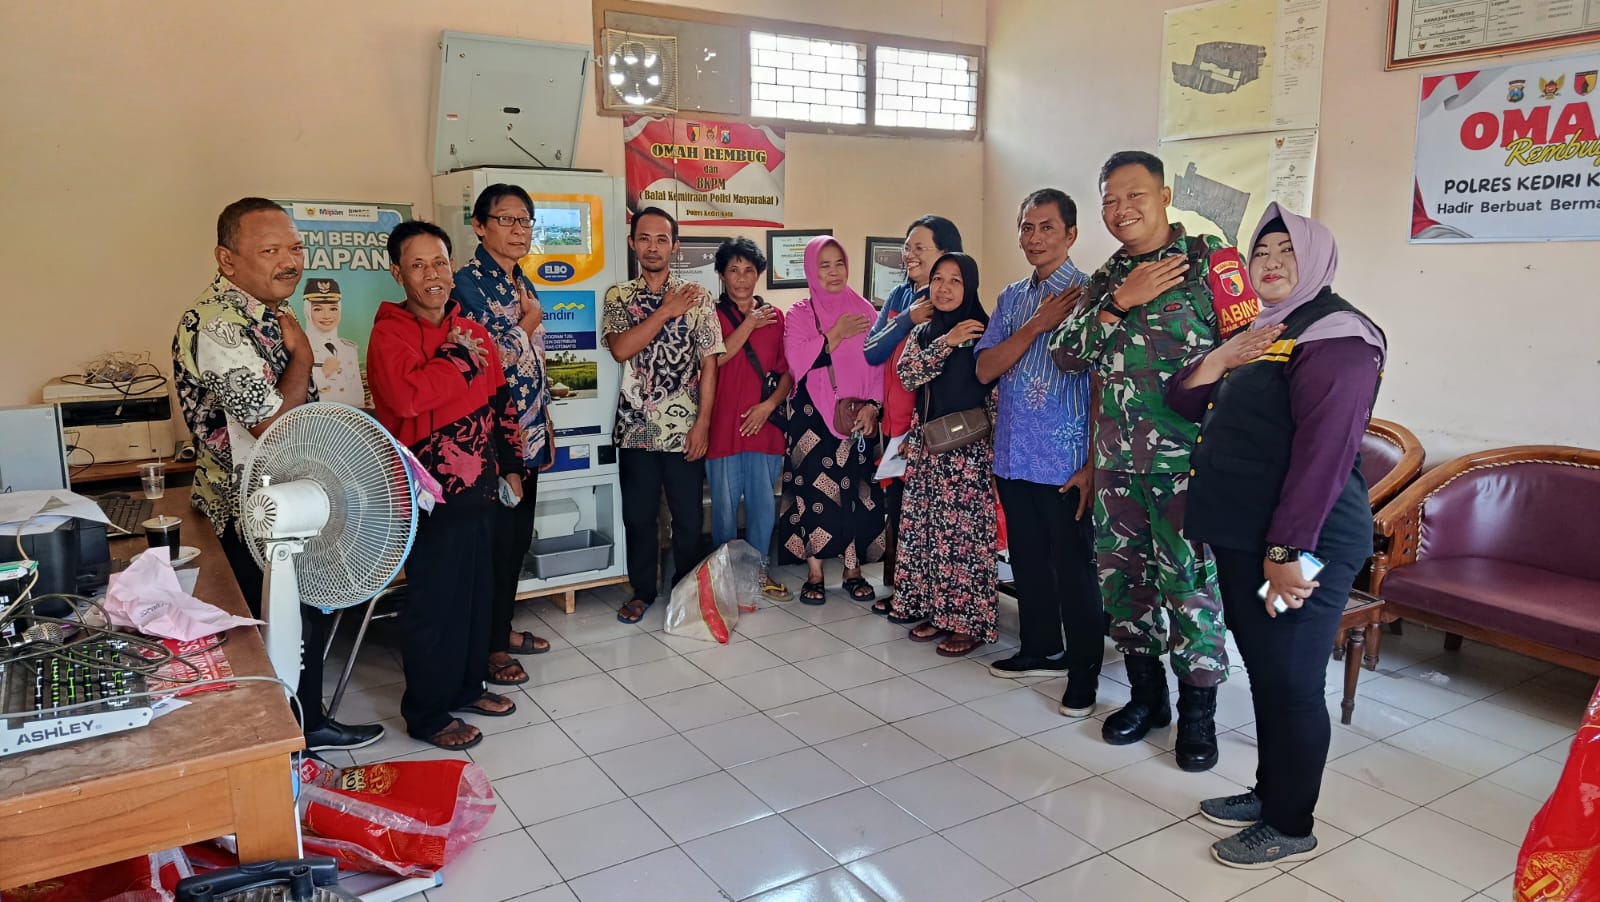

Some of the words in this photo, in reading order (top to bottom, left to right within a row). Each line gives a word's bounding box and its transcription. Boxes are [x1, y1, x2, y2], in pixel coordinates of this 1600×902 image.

[1460, 101, 1600, 151] OMA
[651, 144, 699, 160] OMAH
[703, 147, 767, 164] REMBUG
[703, 164, 718, 174] dan
[696, 177, 726, 190] BKPM
[1444, 177, 1511, 194] POLRES
[1517, 172, 1581, 190] KEDIRI
[668, 191, 708, 202] Kemitraan
[710, 192, 731, 203] Polisi
[733, 193, 774, 206] Masyarakat
[1437, 202, 1474, 214] Hadir
[1480, 199, 1542, 213] Berbuat
[328, 231, 389, 247] BERAS
[544, 265, 568, 274] ELBO
[17, 719, 94, 746] ASHLEY
